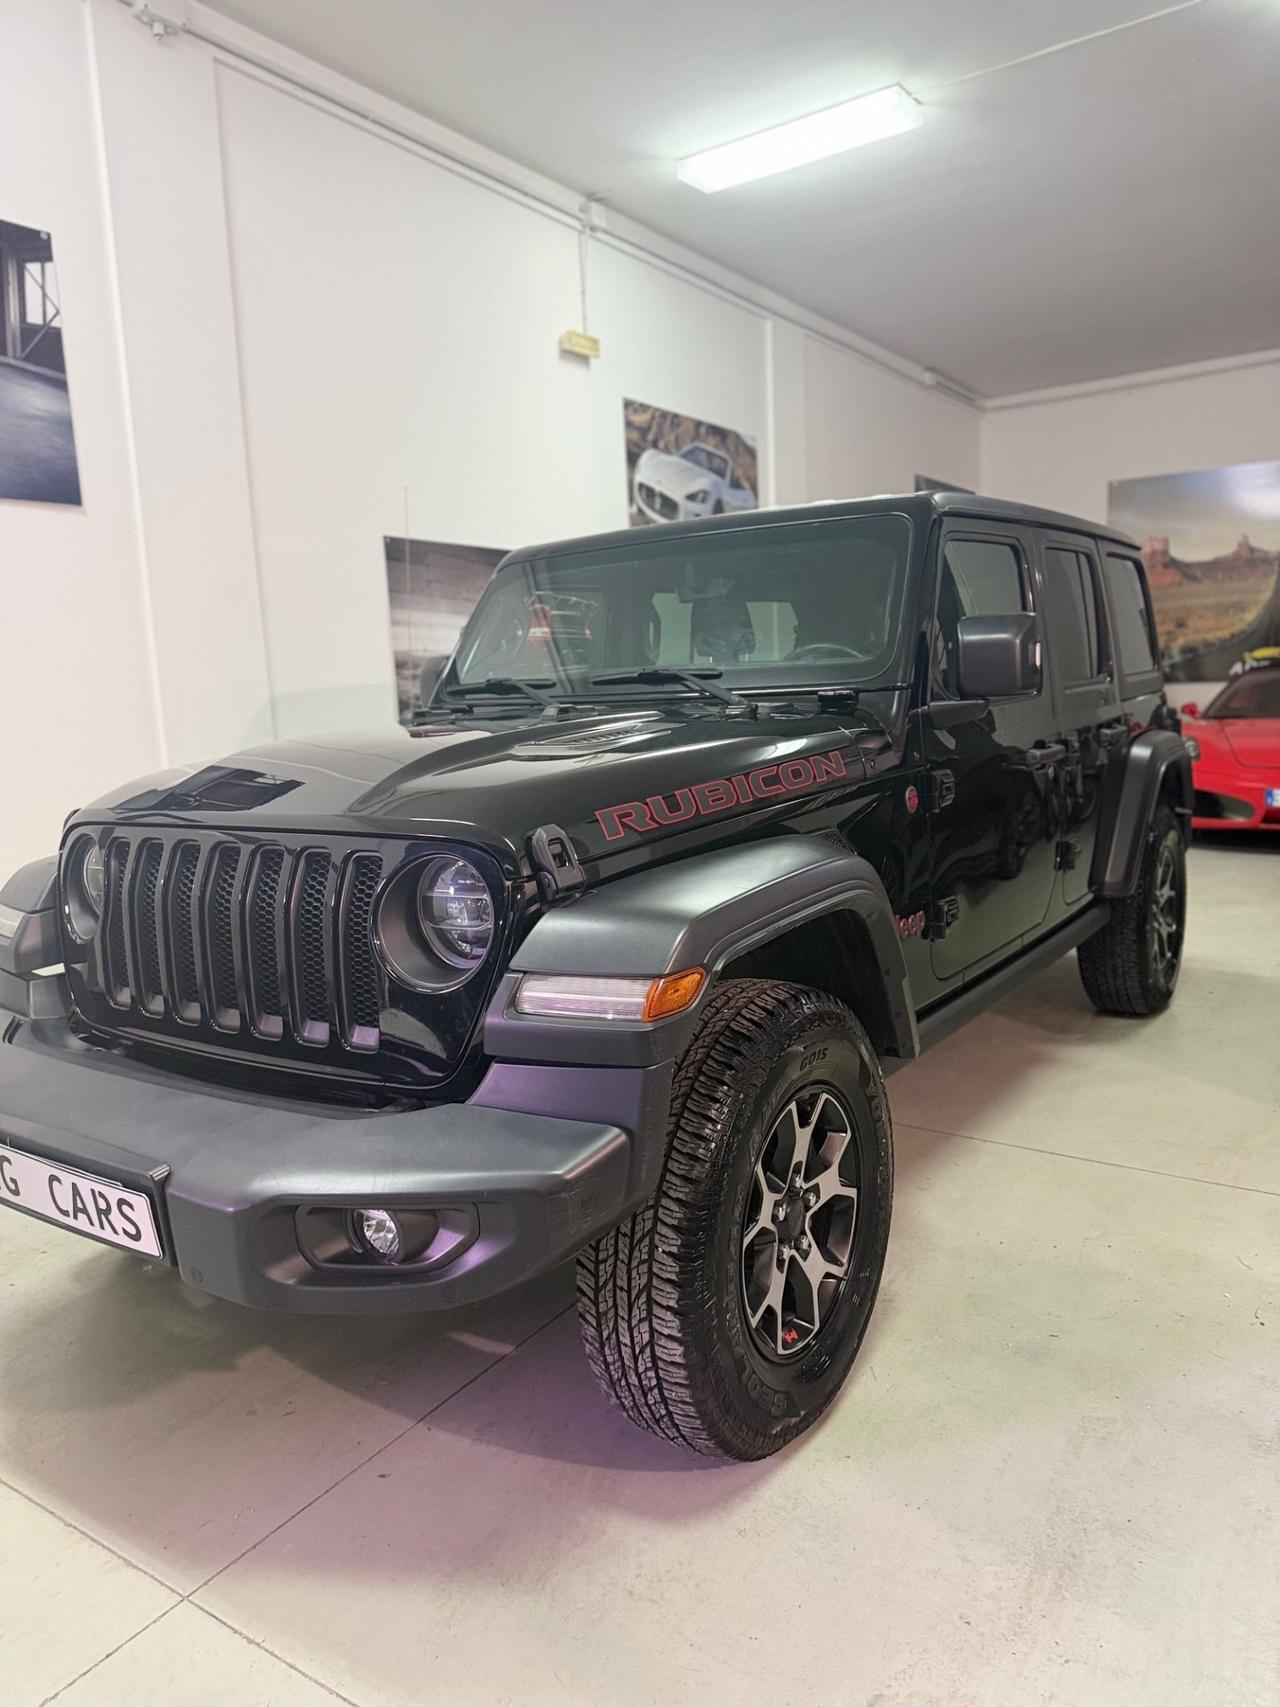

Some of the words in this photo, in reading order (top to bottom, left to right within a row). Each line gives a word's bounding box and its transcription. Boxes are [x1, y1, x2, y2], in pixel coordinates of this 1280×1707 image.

[594, 751, 847, 841] RUBICON
[0, 1154, 21, 1197] G
[47, 1173, 142, 1242] CARS
